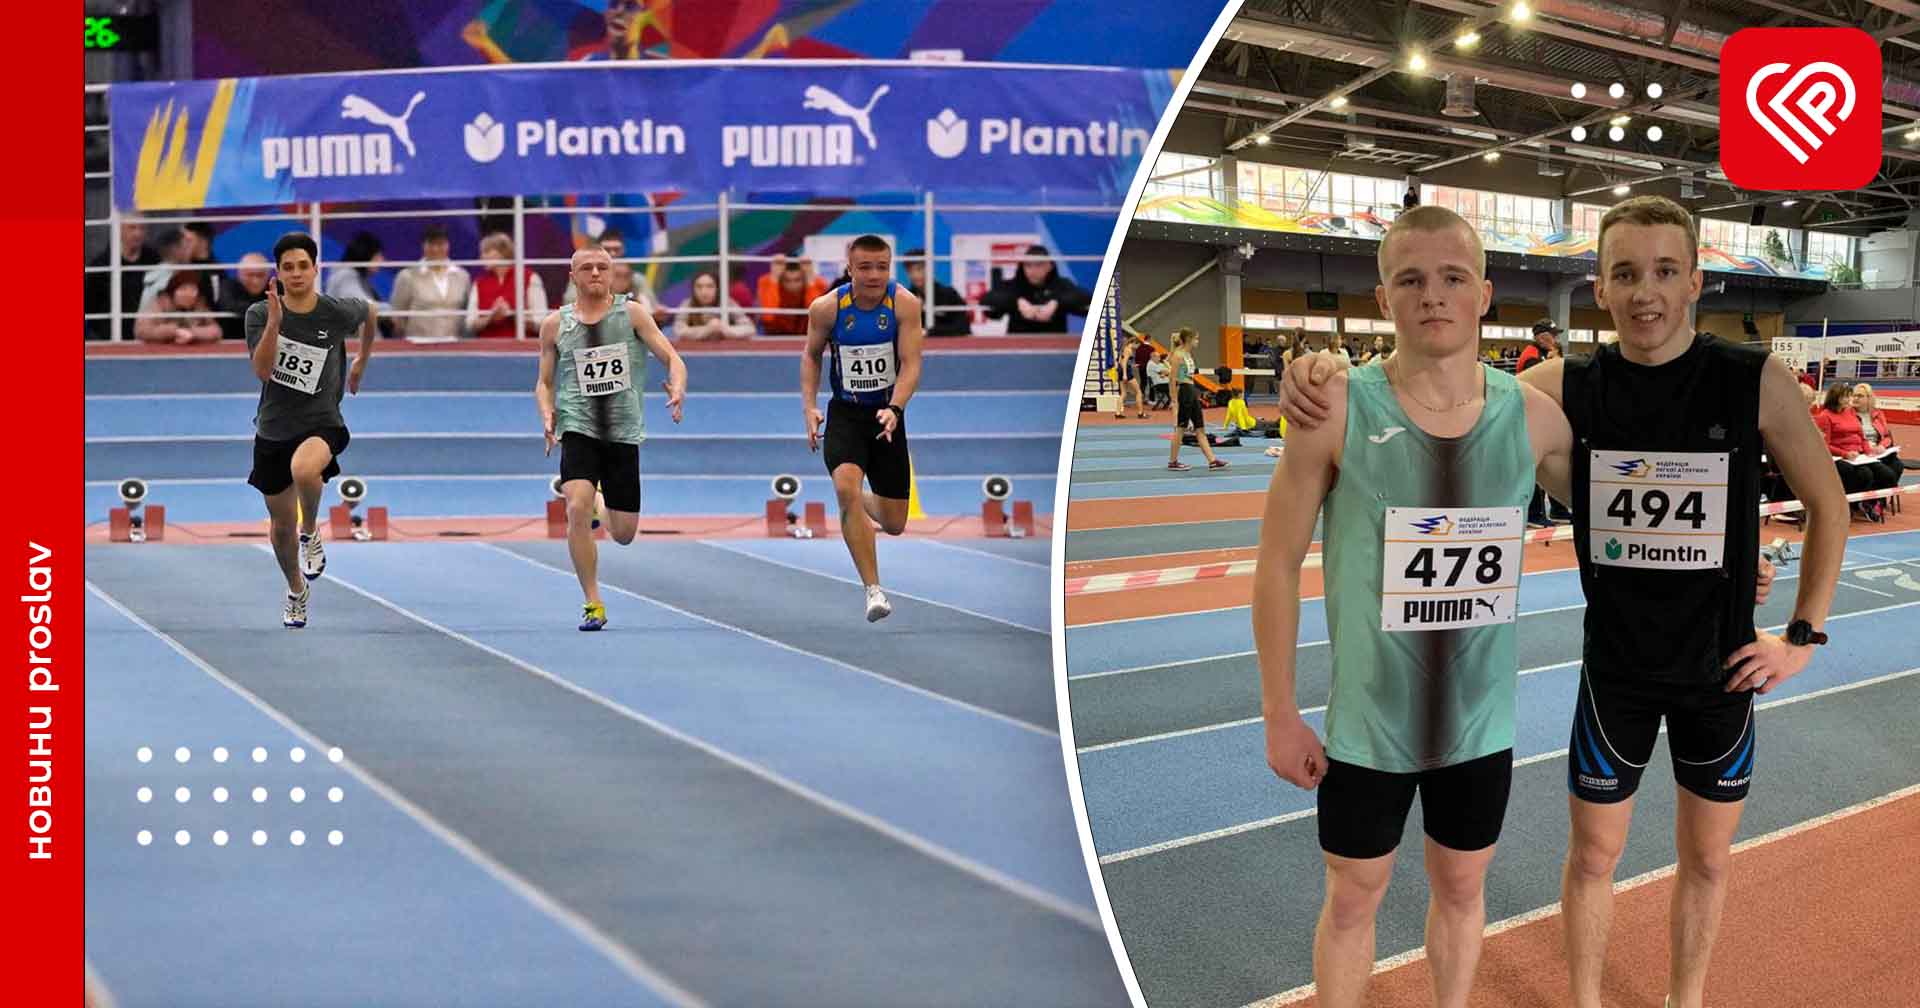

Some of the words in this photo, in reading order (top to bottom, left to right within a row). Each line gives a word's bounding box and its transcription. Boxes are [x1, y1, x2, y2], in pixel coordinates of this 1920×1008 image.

[262, 133, 392, 179] PUMA
[722, 125, 853, 167] PUMA
[279, 352, 313, 375] 183
[583, 359, 623, 379] 478
[850, 358, 886, 375] 410
[586, 381, 614, 393] PUMA
[850, 379, 879, 389] PUMA
[1607, 489, 1706, 529] 494
[1628, 544, 1707, 562] PlantIn
[1404, 545, 1503, 588] 478
[1404, 599, 1473, 623] PUMA
